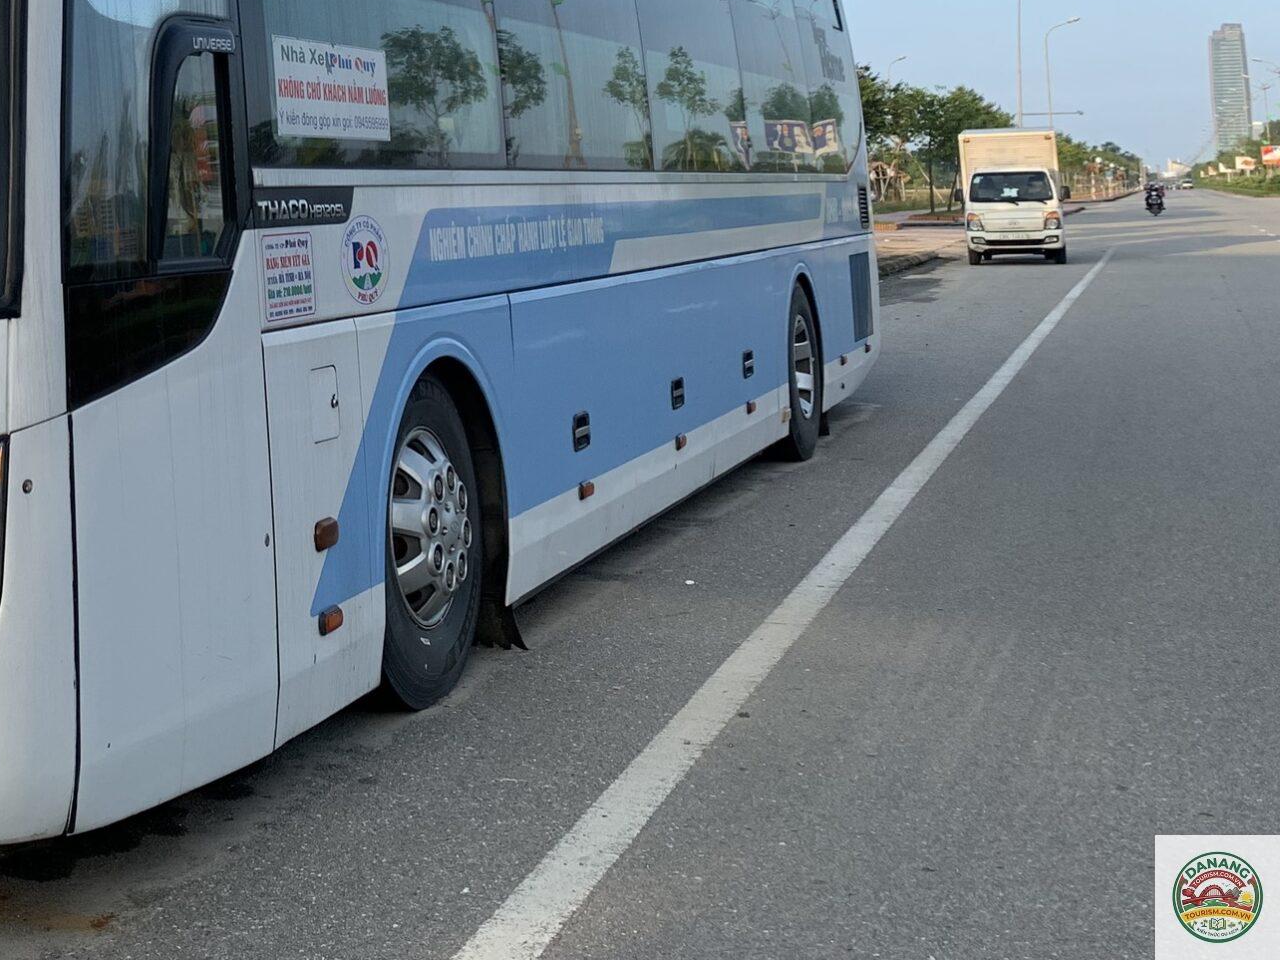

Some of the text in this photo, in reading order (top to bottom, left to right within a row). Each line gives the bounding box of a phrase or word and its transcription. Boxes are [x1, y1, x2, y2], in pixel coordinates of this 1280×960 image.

[280, 44, 306, 64] Nhà
[309, 47, 325, 66] Xe
[277, 74, 305, 99] KHÔNG
[323, 79, 347, 103] KHÁCH
[257, 199, 309, 221] THACO
